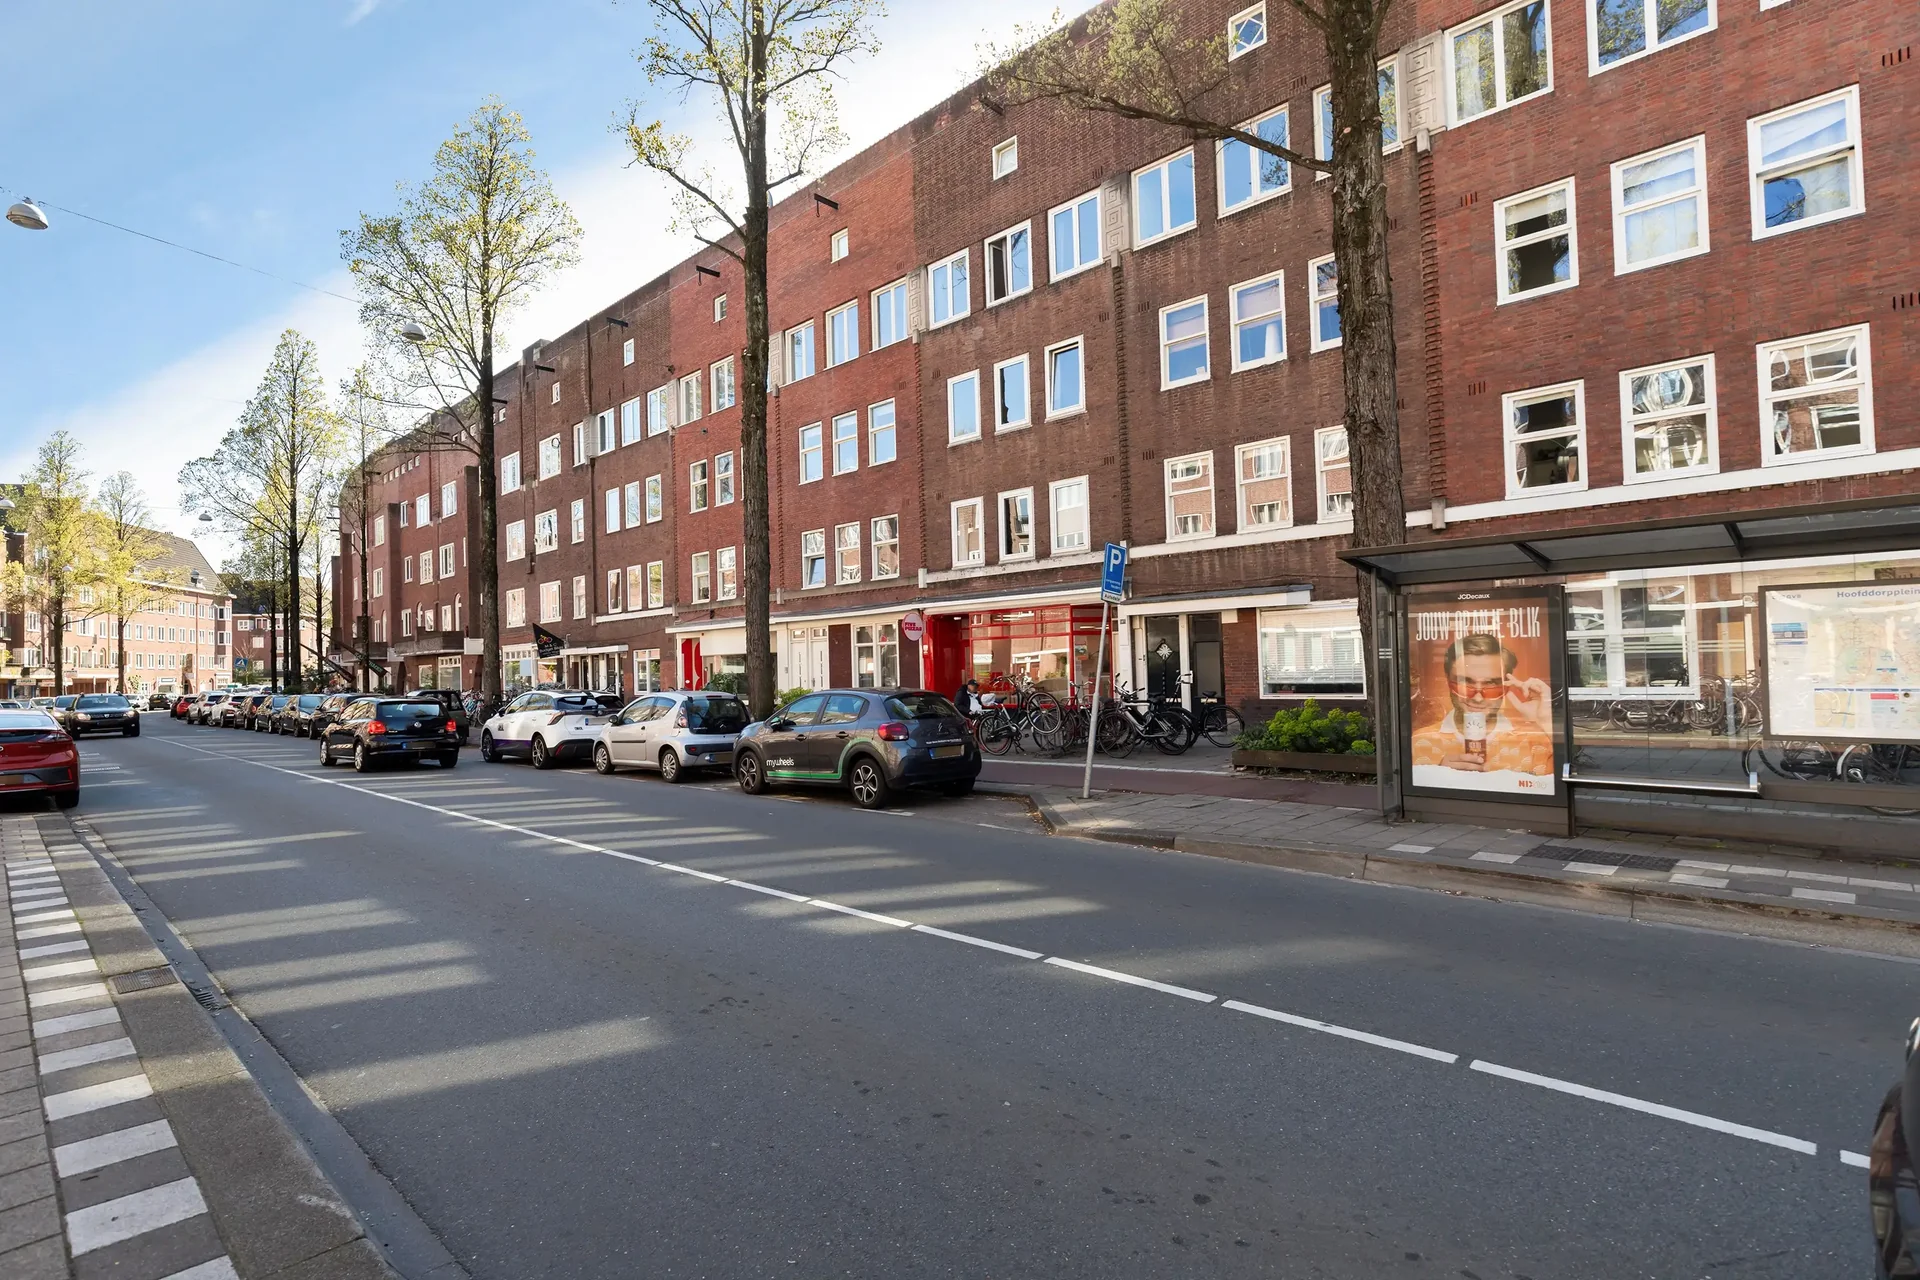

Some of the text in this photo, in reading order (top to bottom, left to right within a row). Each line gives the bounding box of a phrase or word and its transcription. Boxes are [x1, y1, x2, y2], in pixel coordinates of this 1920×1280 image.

[1110, 549, 1122, 572] P
[1837, 588, 1920, 598] Hoofddorpplein
[1416, 611, 1449, 641] JOUW
[1510, 606, 1540, 638] BLIK
[766, 757, 794, 767] mywheels
